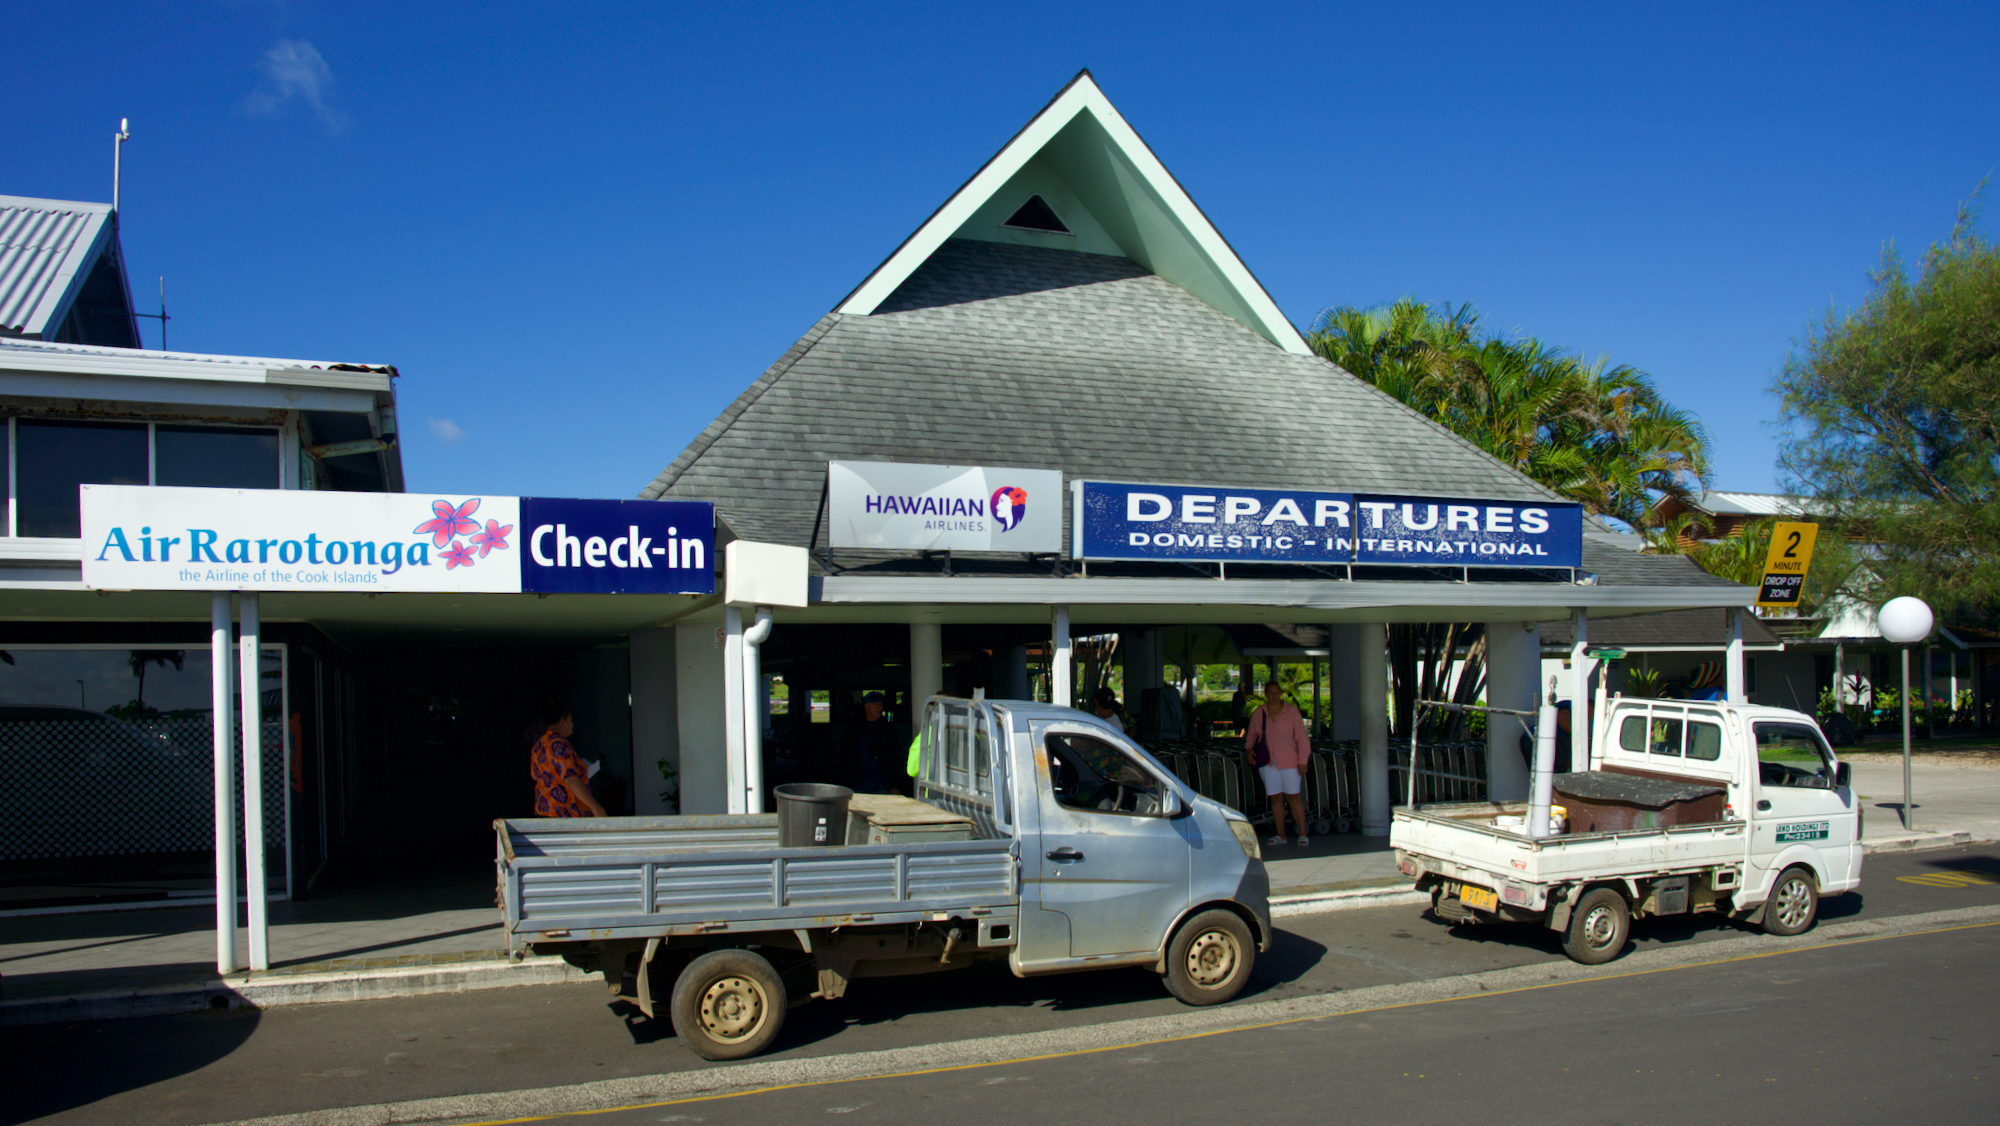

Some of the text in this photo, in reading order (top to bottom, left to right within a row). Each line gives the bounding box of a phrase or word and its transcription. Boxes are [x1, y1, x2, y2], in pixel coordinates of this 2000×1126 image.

[866, 494, 984, 517] HAWAIIAN
[1126, 492, 1550, 534] DEPARTURES
[95, 525, 434, 576] Air Rarotonga
[530, 523, 704, 569] Check-in
[1129, 532, 1293, 550] DOMESTIC
[1326, 537, 1549, 556] INTERNATIONAL
[1784, 531, 1801, 557] 2
[179, 569, 378, 584] the Airline of the Cook Islands
[1773, 562, 1802, 571] MINUTE
[1764, 576, 1803, 586] DROP OFF
[1769, 589, 1791, 598] ZONE
